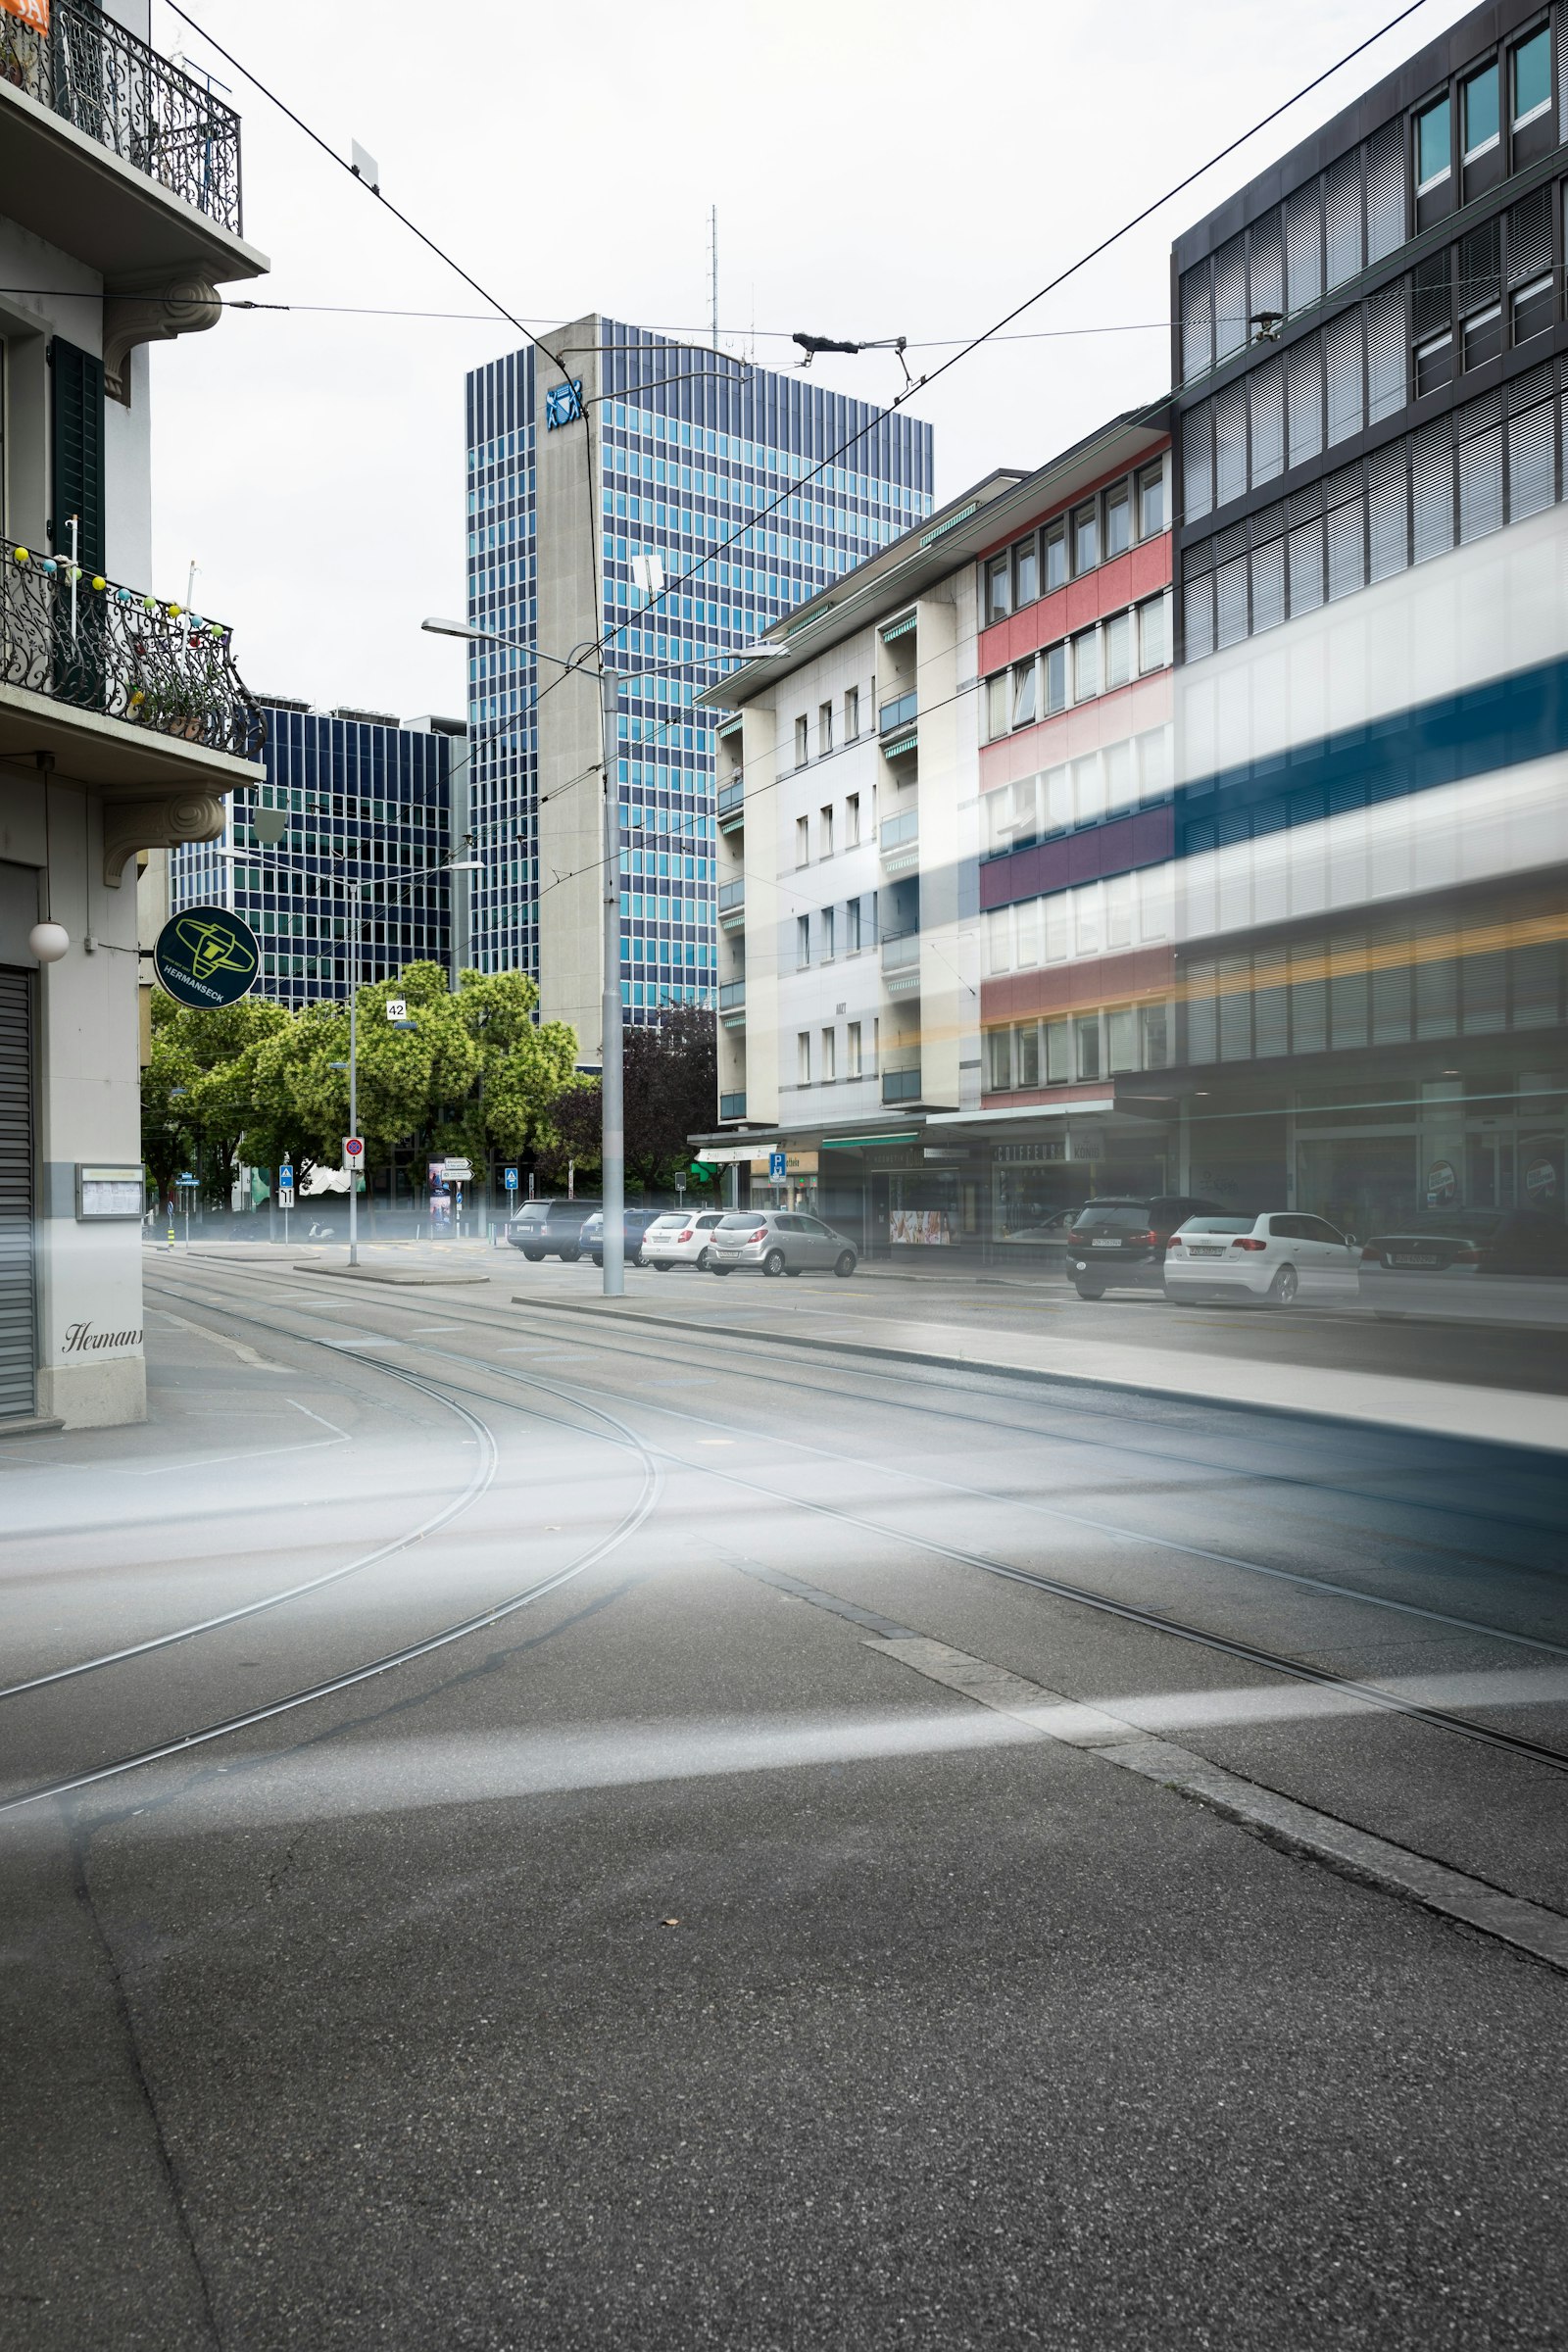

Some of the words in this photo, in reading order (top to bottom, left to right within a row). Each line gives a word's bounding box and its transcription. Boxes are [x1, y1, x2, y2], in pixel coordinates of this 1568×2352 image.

[163, 964, 224, 1004] HERMANSECK
[388, 1004, 404, 1015] 42
[998, 1144, 1055, 1161] COIFFEUR
[775, 1155, 782, 1166] P
